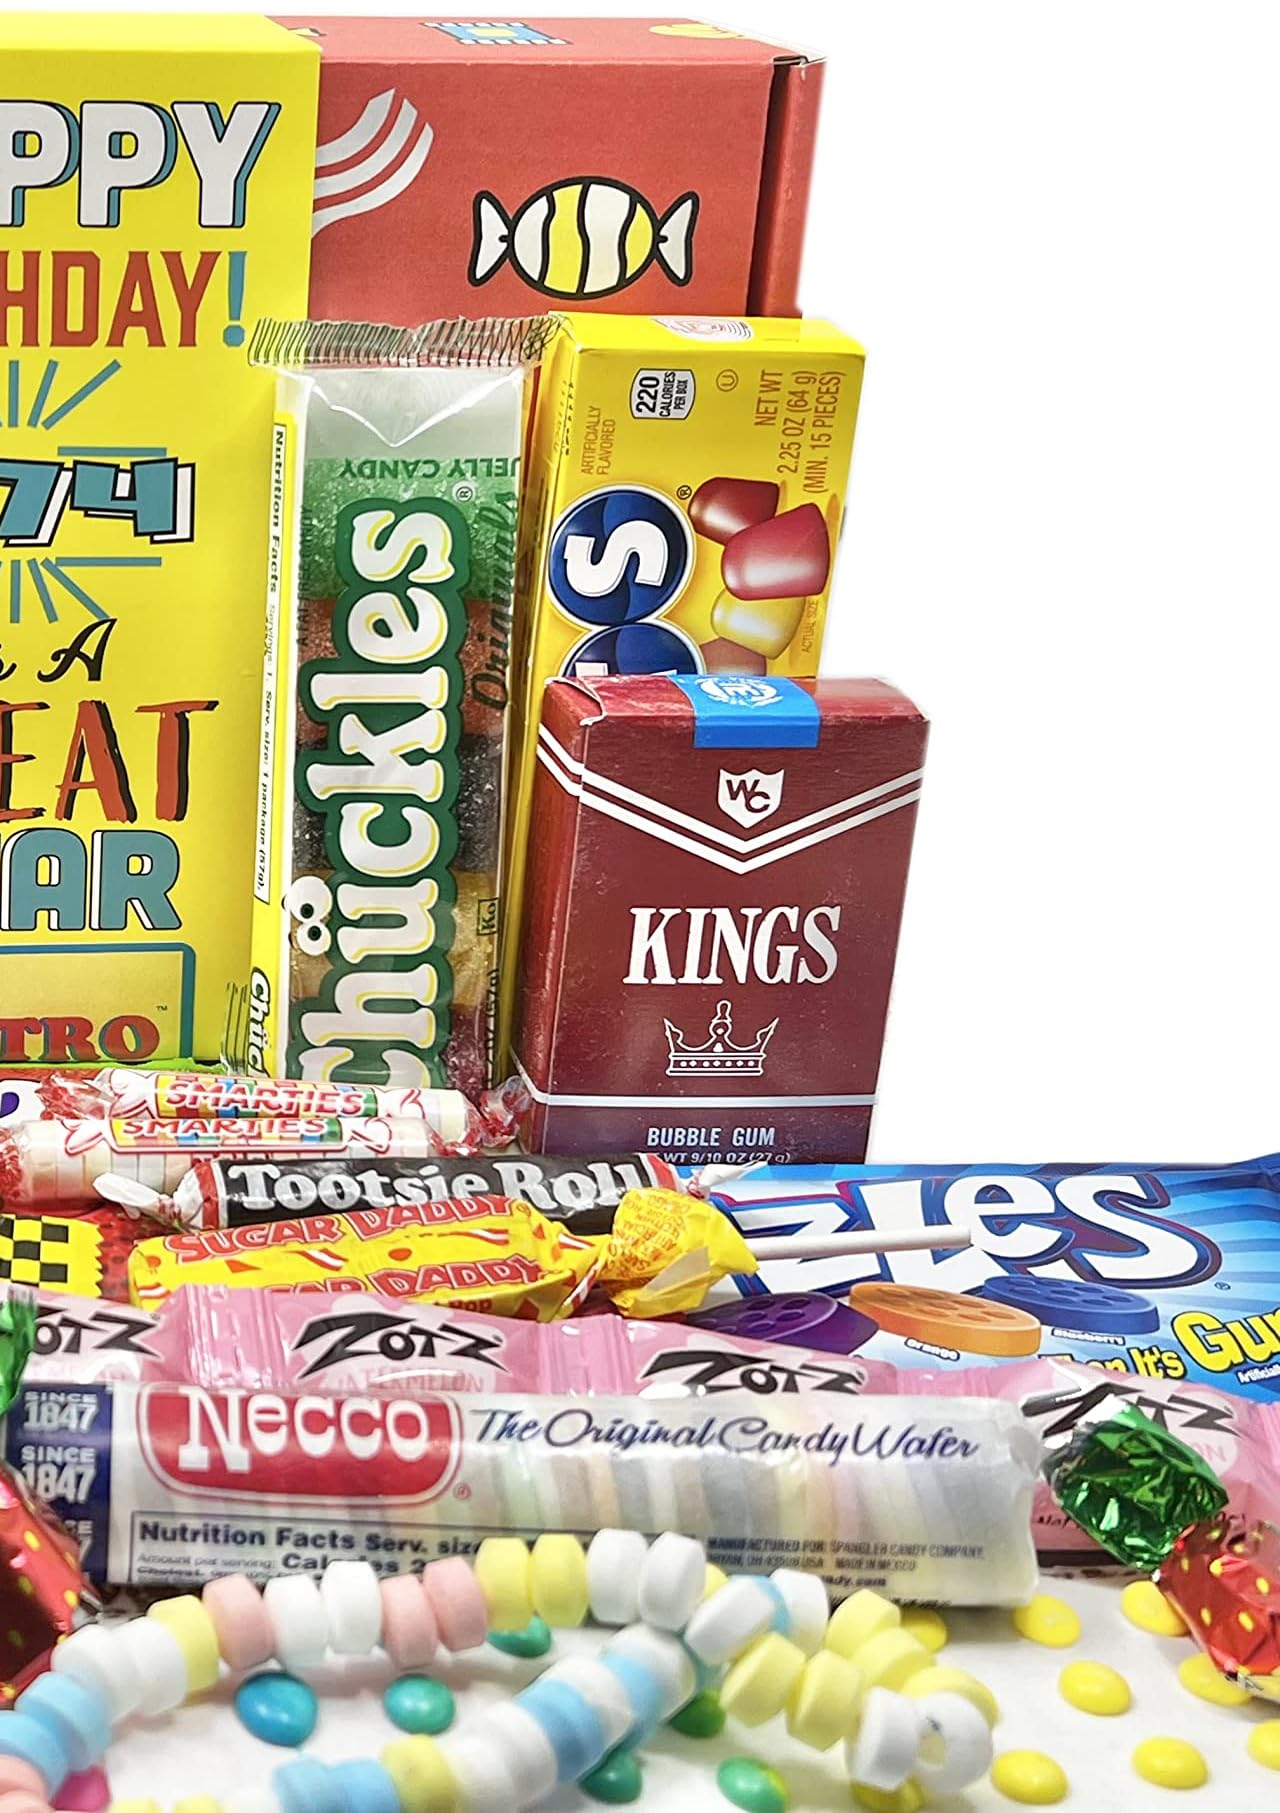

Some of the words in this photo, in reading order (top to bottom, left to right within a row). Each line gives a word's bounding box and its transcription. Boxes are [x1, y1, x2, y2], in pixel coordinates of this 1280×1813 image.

[636, 375, 660, 413] 220
[659, 371, 676, 417] CALORIES
[676, 379, 688, 394] BOX
[759, 369, 783, 394] WT
[812, 370, 846, 428] PIECES)
[673, 395, 686, 410] PER
[754, 397, 779, 426] NET
[580, 405, 601, 475] ARTIFICIALLY
[781, 417, 805, 437] OZ
[809, 433, 832, 450] 15
[596, 418, 616, 475] FLAVORED
[776, 442, 802, 474] 2.25
[272, 430, 285, 527] Nutrition
[339, 458, 441, 479] CANDY
[802, 456, 829, 494] (MIN.
[269, 535, 282, 593] Facts
[37, 617, 117, 683] A
[623, 906, 841, 985] KINGS
[165, 1080, 365, 1116] SMARTIES
[122, 1116, 328, 1136] SMARTIES
[647, 1127, 722, 1147] BUBBLE
[732, 1127, 776, 1147] GUM
[228, 1162, 492, 1211] Tootsie
[492, 1160, 641, 1215] Roll
[163, 1213, 345, 1263] SUGAR
[344, 1195, 517, 1240] DADDY
[368, 1254, 544, 1299] DADDY
[23, 1390, 99, 1403] SINCE
[22, 1400, 99, 1433] 1847
[176, 1388, 431, 1475] Necco
[21, 1445, 96, 1463] SINCE
[469, 1407, 544, 1446] The
[544, 1407, 719, 1452] Original
[719, 1415, 855, 1468] Candy
[20, 1461, 97, 1504] 1847
[138, 1521, 268, 1548] Nutrition
[276, 1527, 356, 1551] Facts
